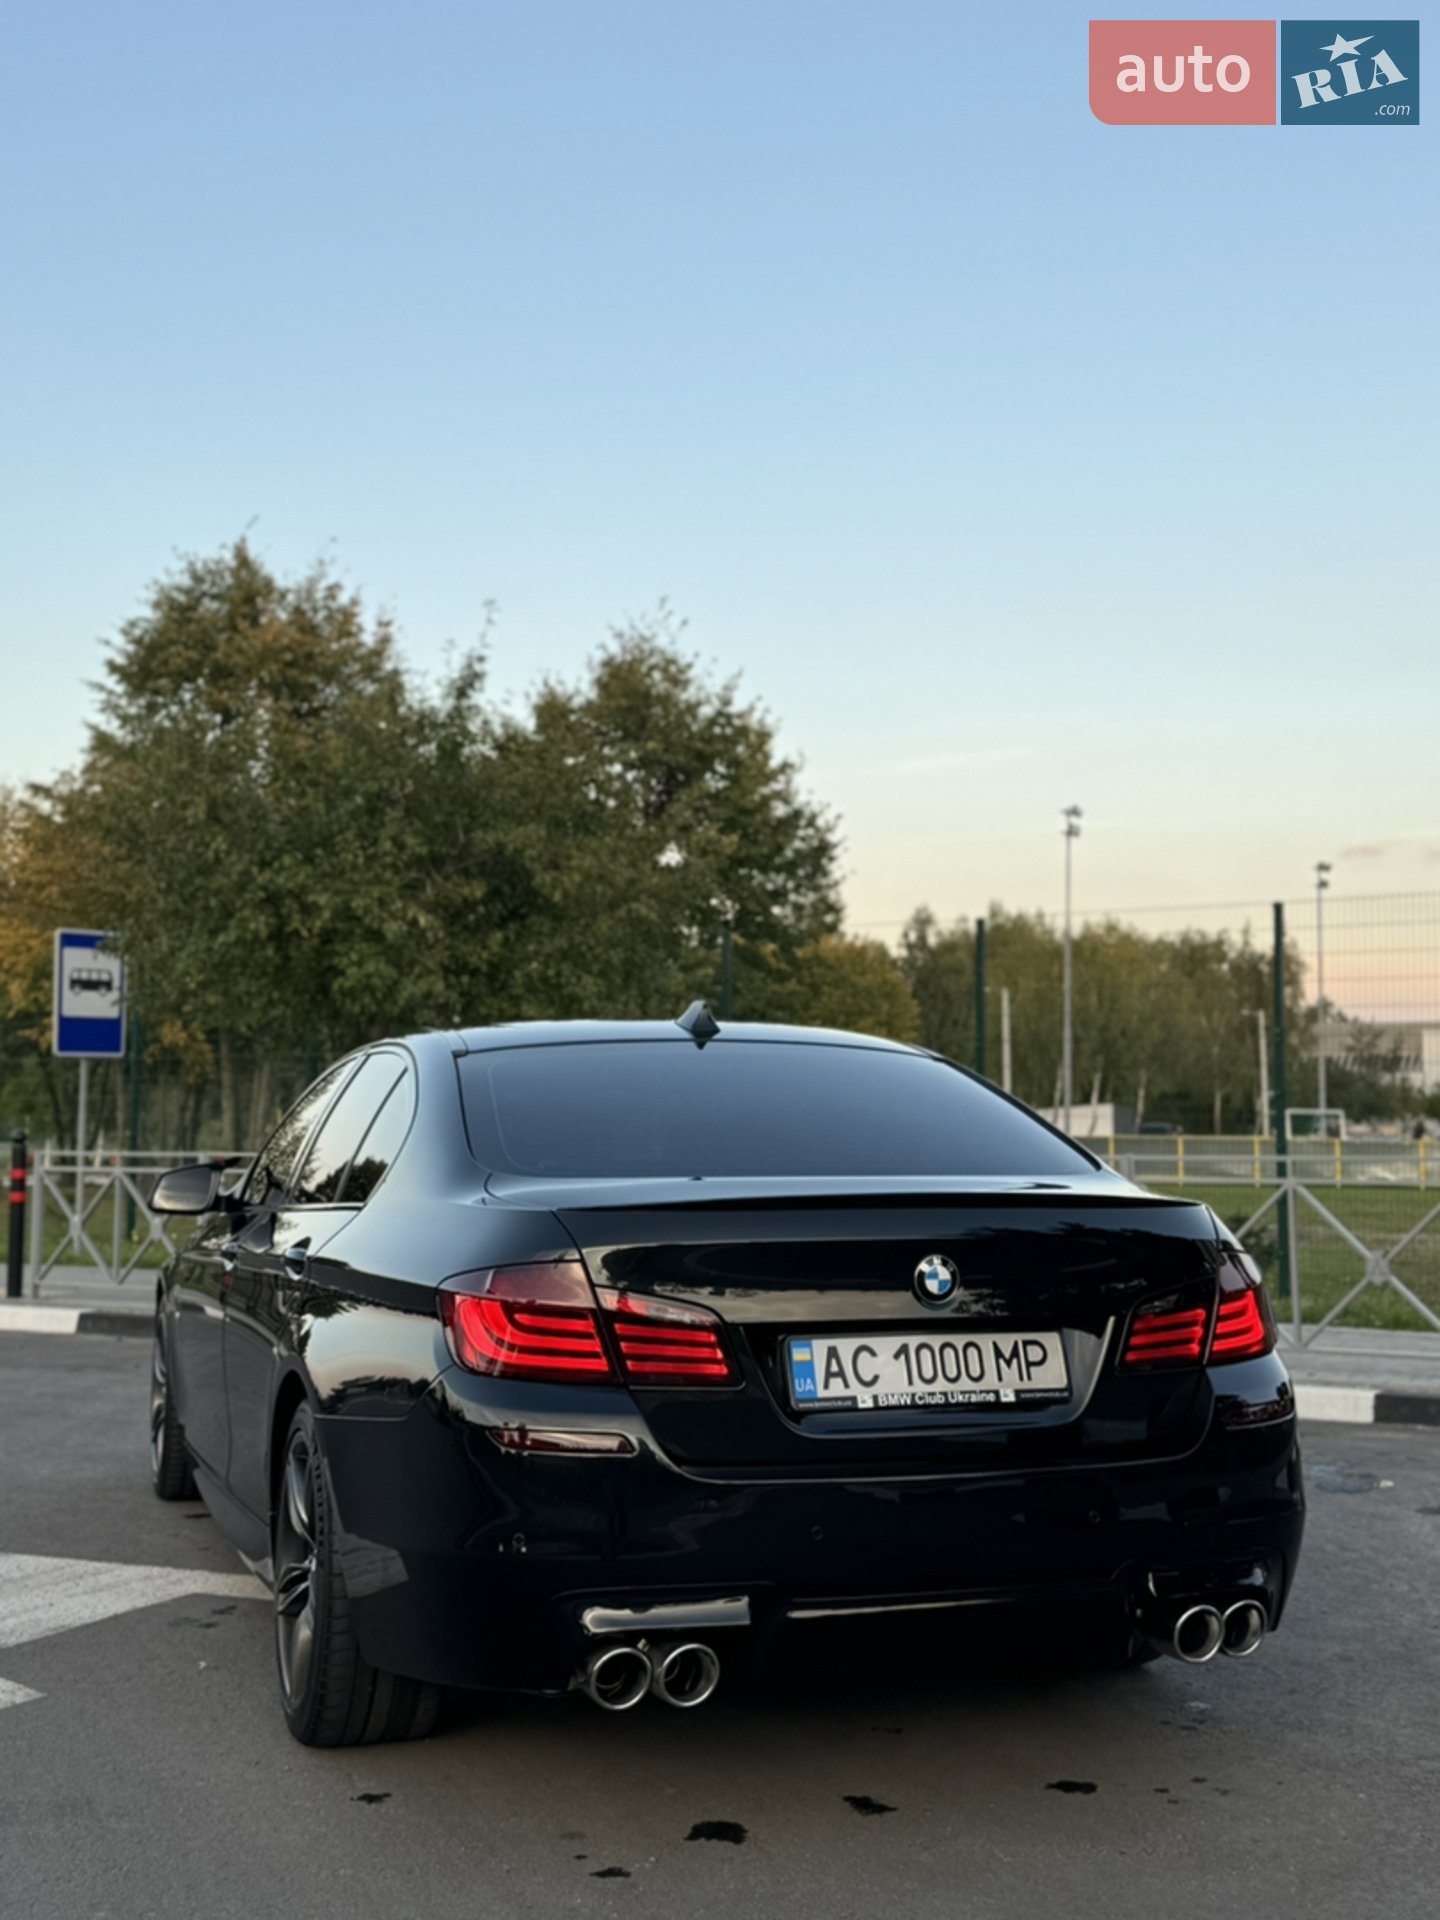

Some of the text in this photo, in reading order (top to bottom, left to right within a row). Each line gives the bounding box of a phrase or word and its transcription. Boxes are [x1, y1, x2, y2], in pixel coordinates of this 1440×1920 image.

[822, 1339, 1049, 1391] AC 1000 MP
[795, 1377, 815, 1392] UA
[878, 1389, 997, 1407] BMW Club Ukraine
